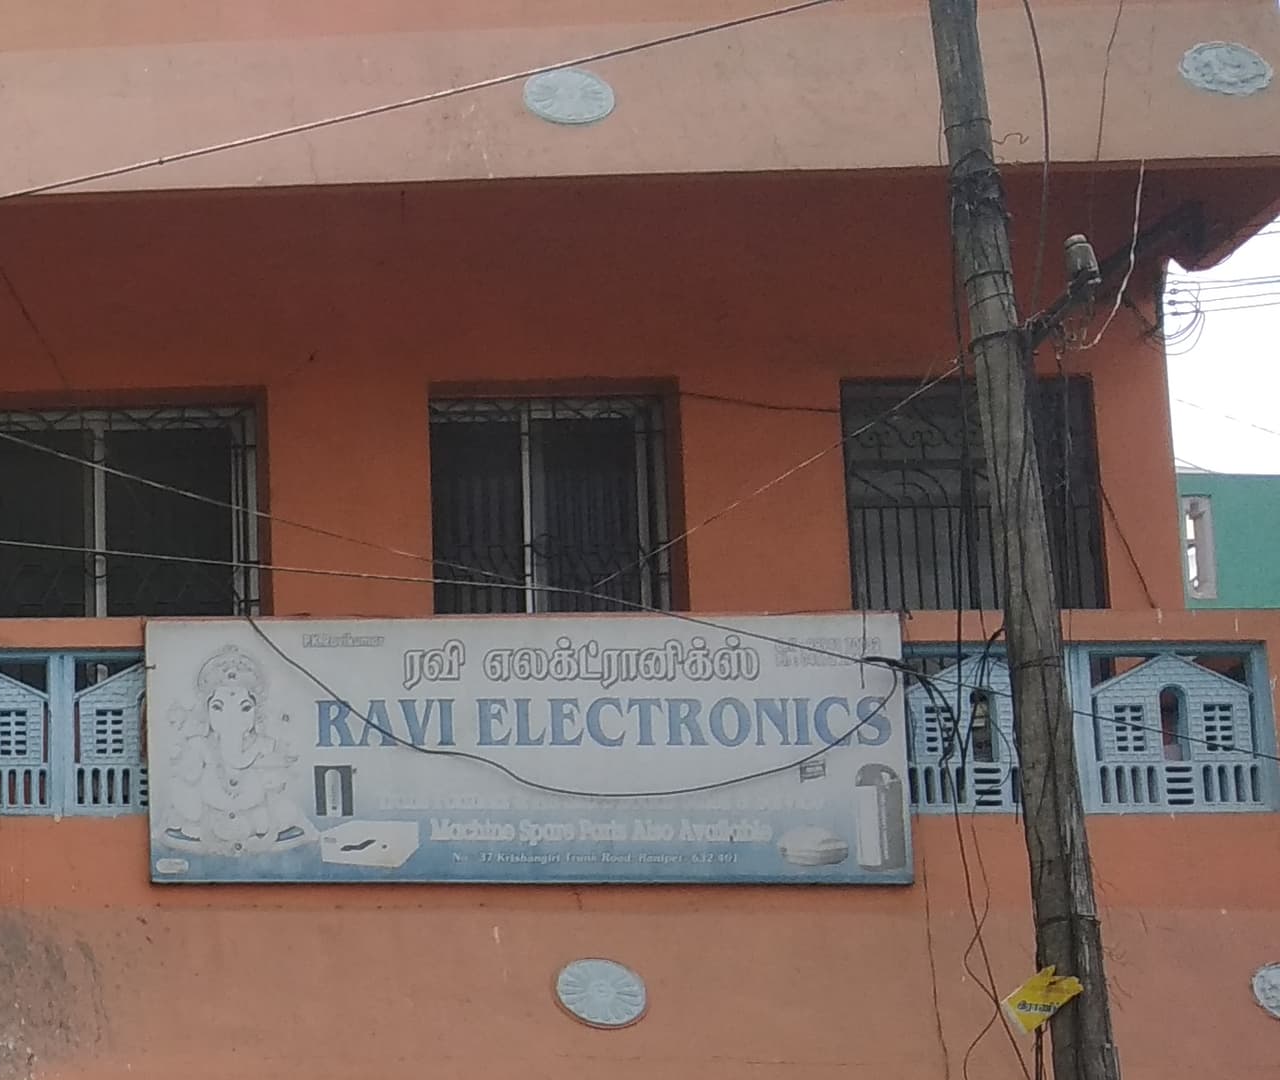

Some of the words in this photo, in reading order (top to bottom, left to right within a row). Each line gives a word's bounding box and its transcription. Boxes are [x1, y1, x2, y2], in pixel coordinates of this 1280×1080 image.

[402, 638, 466, 690] ரவி
[315, 698, 455, 748] RAVI
[475, 696, 894, 748] ELECTRONICS
